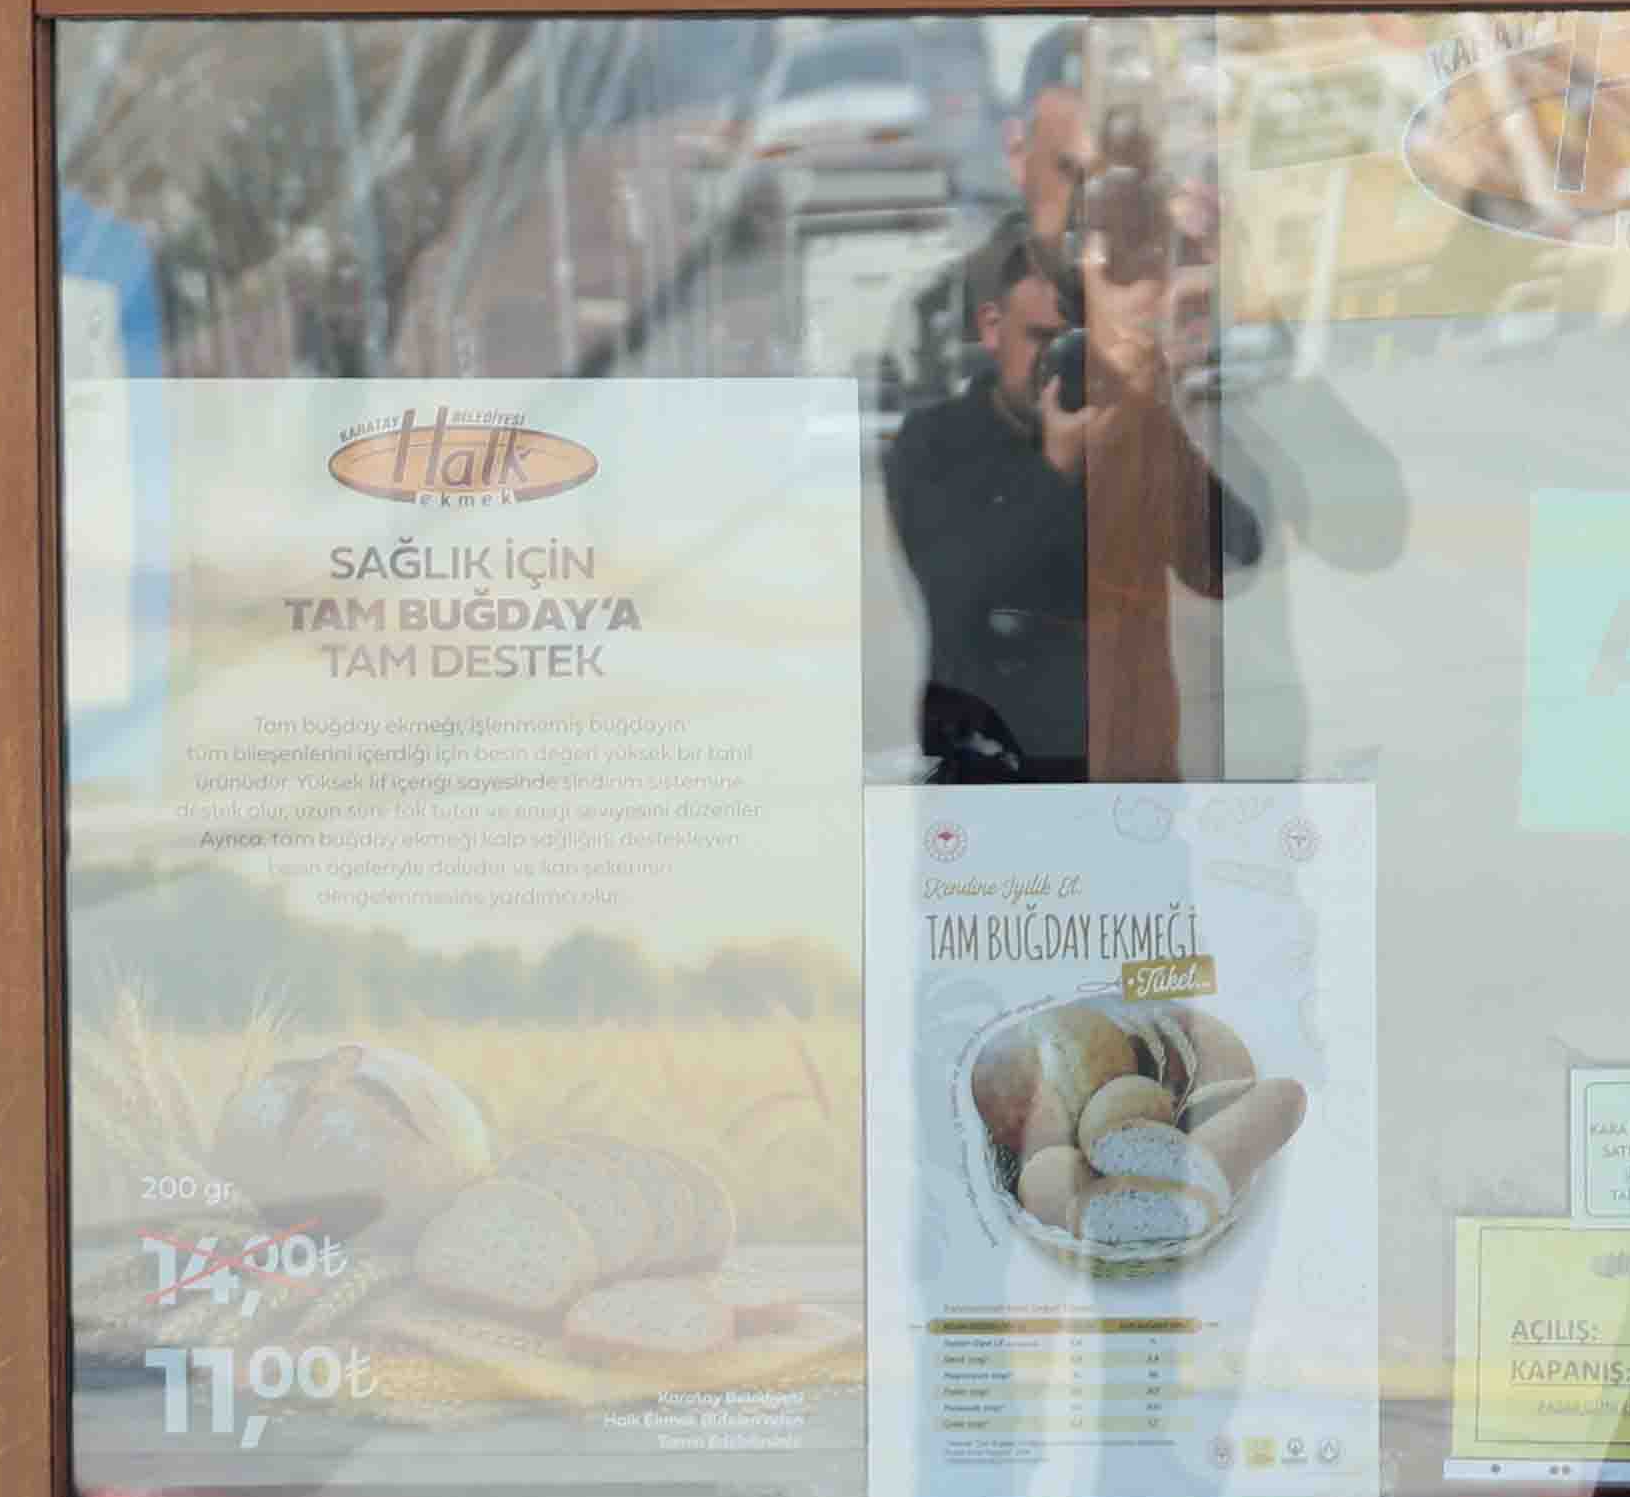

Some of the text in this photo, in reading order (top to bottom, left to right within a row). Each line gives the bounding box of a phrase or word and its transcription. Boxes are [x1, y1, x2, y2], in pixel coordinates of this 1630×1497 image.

[338, 415, 401, 442] KARATAY
[393, 405, 532, 487] Halk
[420, 489, 515, 508] ekmek
[329, 536, 596, 591] SAĞLIK İÇİN
[284, 596, 386, 632] TAM
[319, 643, 608, 680] TAM DESTEK
[253, 716, 297, 734] Tam
[302, 715, 380, 738] buğday
[186, 743, 228, 762] tüm
[233, 742, 351, 766] bileşenlerini
[358, 742, 431, 766] içerdiği
[436, 743, 469, 766] için
[925, 900, 1199, 962] TAM BUĞDAY EKMEĞİ
[1590, 1119, 1628, 1136] KARA
[140, 1175, 235, 1207] 200 gr
[1510, 1318, 1603, 1345] AÇILIŞ:
